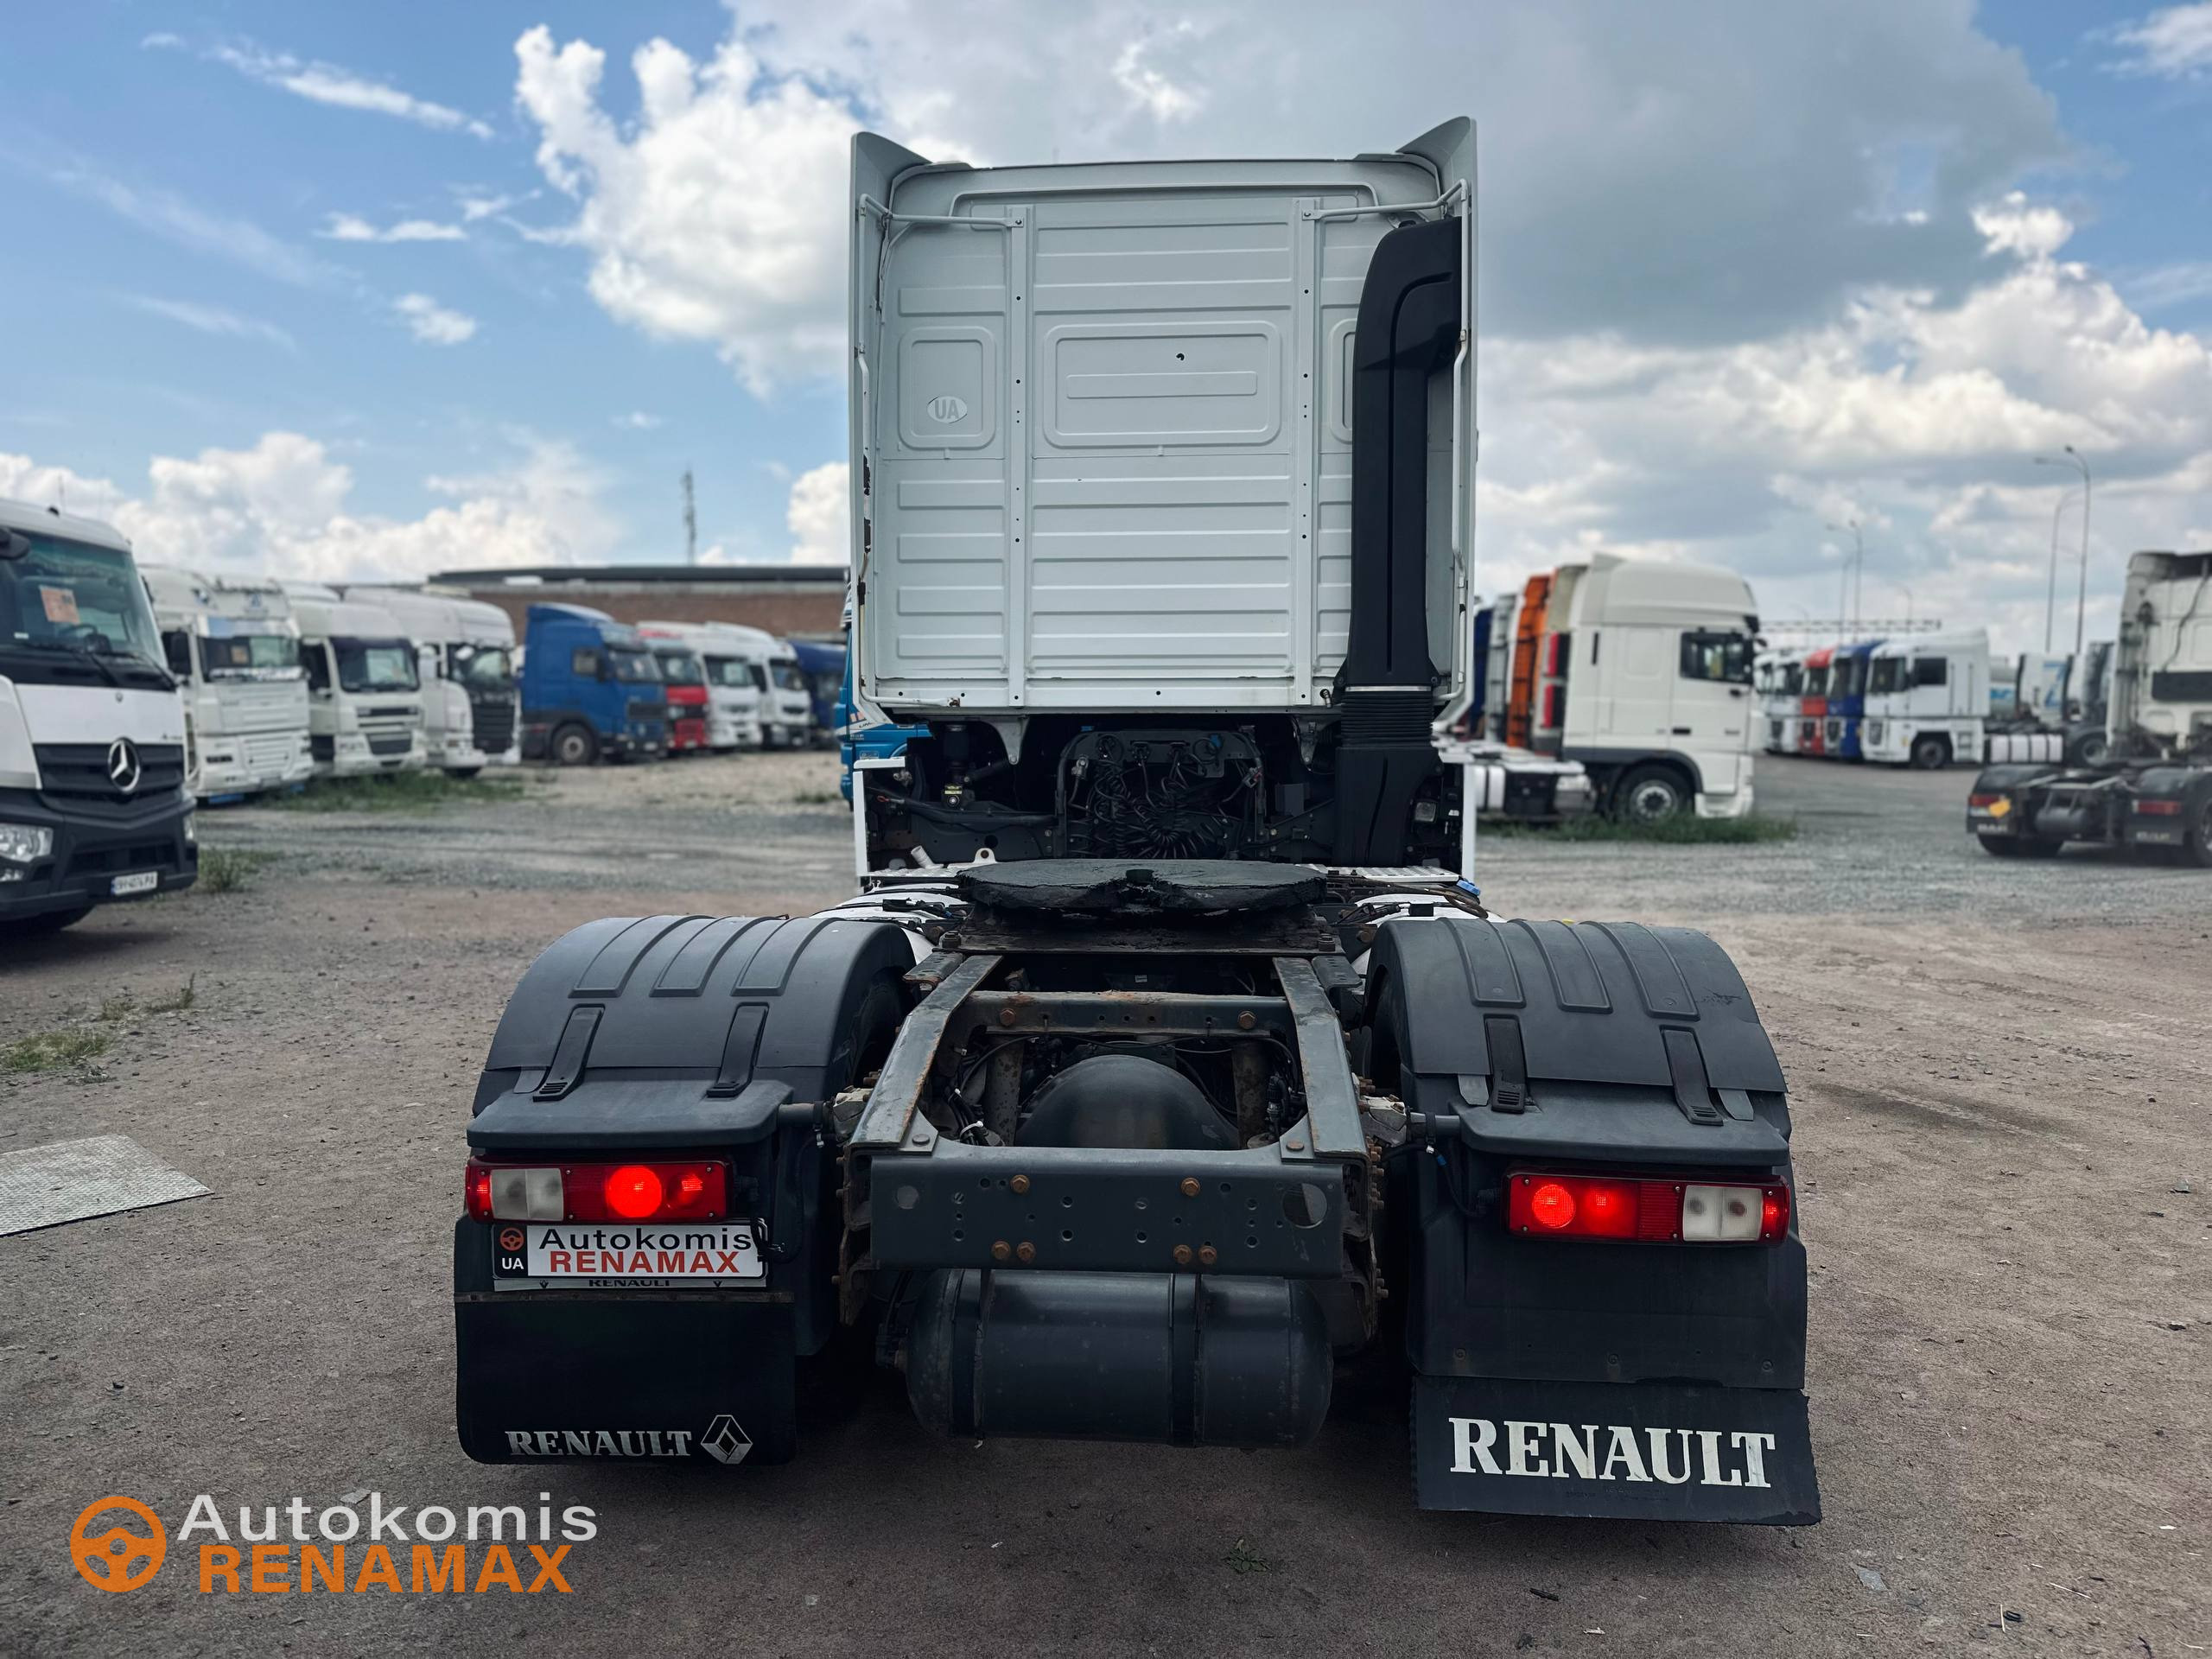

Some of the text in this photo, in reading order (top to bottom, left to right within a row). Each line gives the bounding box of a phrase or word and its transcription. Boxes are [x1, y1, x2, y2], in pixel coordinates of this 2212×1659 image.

[934, 399, 959, 419] UA
[538, 1228, 752, 1250] Autokomis
[501, 1257, 524, 1270] UA
[550, 1250, 741, 1273] RENAMAX
[505, 1430, 692, 1457] RENAULT
[1448, 1417, 1776, 1489] RENAULT
